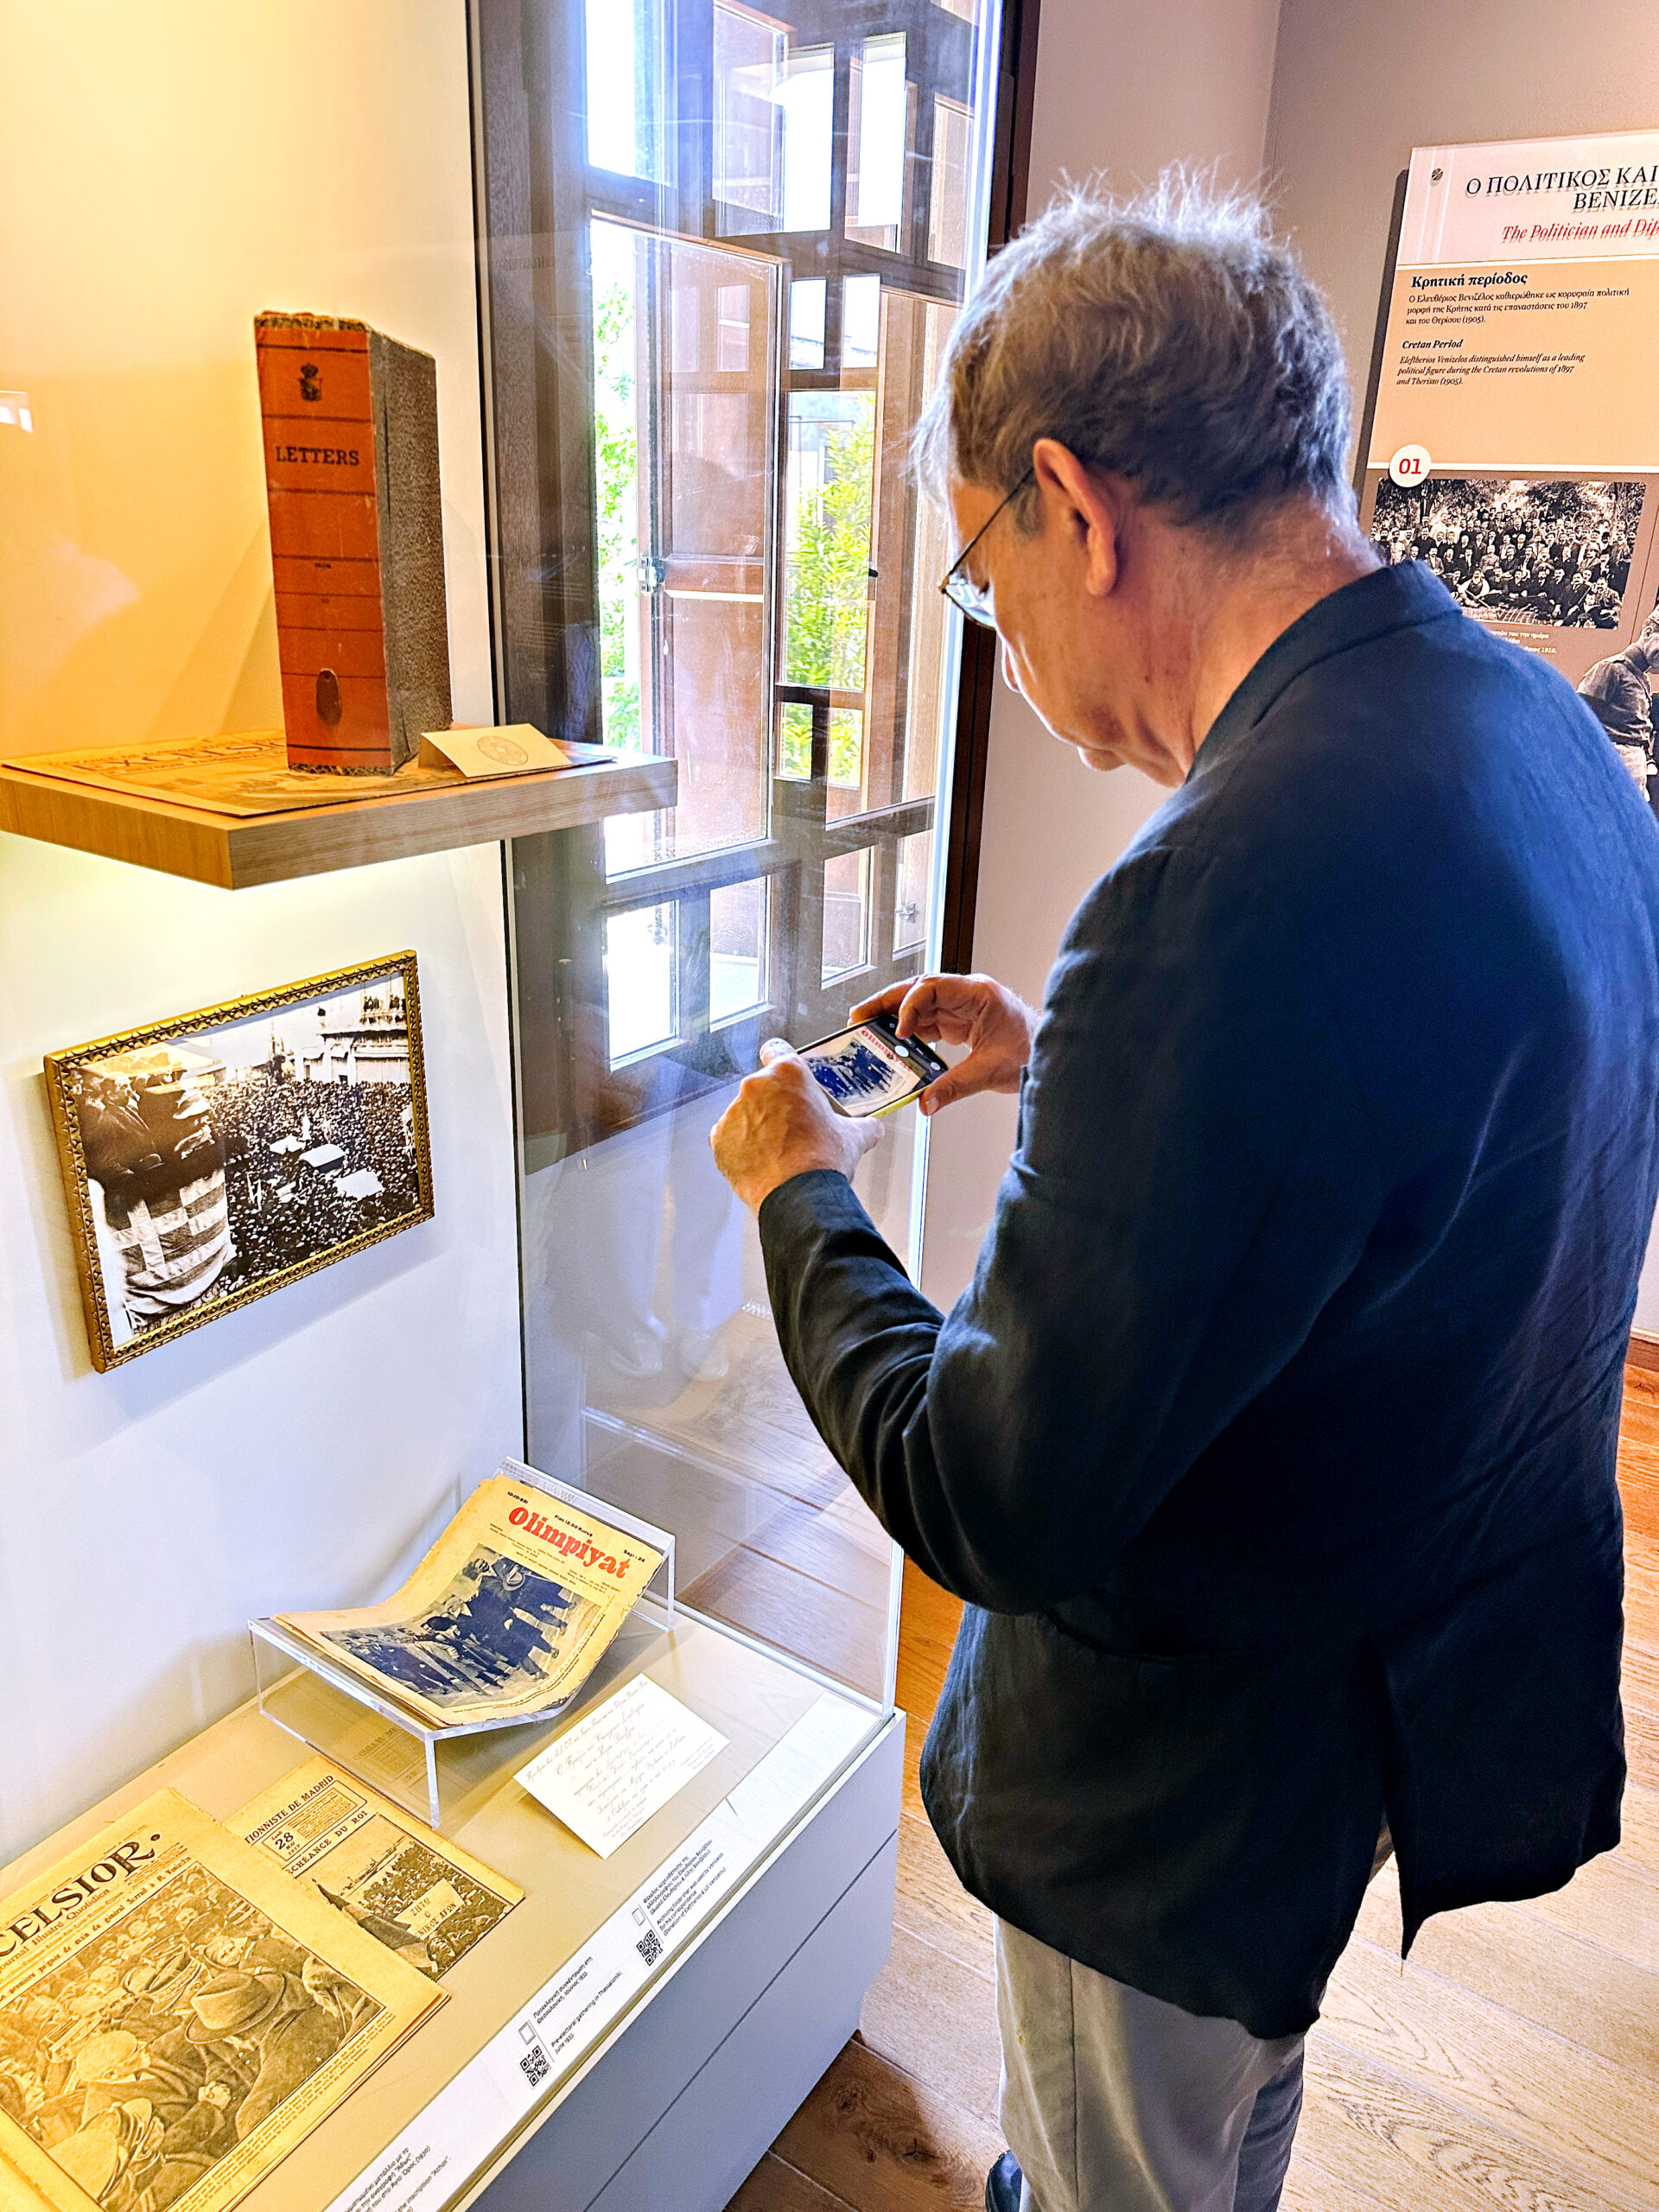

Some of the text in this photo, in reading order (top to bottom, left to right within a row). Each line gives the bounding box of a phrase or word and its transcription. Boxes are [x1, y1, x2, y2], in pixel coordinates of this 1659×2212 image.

[1466, 165, 1658, 194] Ο ΠΟΛΙΤΙΚΟΣ ΚΑΙ
[1573, 188, 1659, 209] ΒΕΝΙΖΕ
[1503, 225, 1528, 240] The
[1530, 222, 1599, 238] Politician
[1601, 219, 1632, 235] and
[1411, 271, 1528, 290] Κρητική περίοδος
[1417, 293, 1457, 303] Ελευθέριος
[1459, 292, 1494, 302] Βενιζέλος
[1495, 290, 1544, 302] καθιερώθηκε
[1558, 288, 1594, 299] κορυφαία
[1596, 287, 1630, 296] πολιτική
[1407, 306, 1431, 315] μορφή
[1446, 304, 1472, 314] Κρήτης
[1503, 302, 1554, 312] επαναστάσεις
[1571, 301, 1587, 310] 1897
[1431, 315, 1461, 326] Θερίσου
[1462, 315, 1485, 324] (1905).
[1402, 339, 1464, 349] Cretan Period
[1400, 355, 1435, 365] Eleftherios
[1437, 355, 1468, 364] Venizelos
[1469, 353, 1516, 364] distinguished
[1516, 353, 1543, 364] himself
[1558, 353, 1586, 363] leading
[1397, 366, 1427, 376] political
[1425, 366, 1446, 376] figure
[1446, 365, 1471, 376] during
[1471, 365, 1482, 373] the
[1508, 365, 1548, 373] revolutions
[1548, 364, 1559, 374] of
[1557, 365, 1575, 373] 1897
[1396, 377, 1464, 385] and Therisso (1905).
[276, 446, 360, 467] LETTERS
[1398, 458, 1422, 475] 01
[508, 1506, 632, 1579] Olimpiyat
[288, 1800, 302, 1811] DE
[301, 1775, 334, 1801] MADRID
[334, 1825, 348, 1837] DU
[352, 1810, 367, 1824] ROI
[275, 1832, 294, 1850] 28
[32, 1921, 64, 1946] Illustré
[67, 1889, 111, 1920] Quotidien
[575, 1999, 596, 2021] gathering
